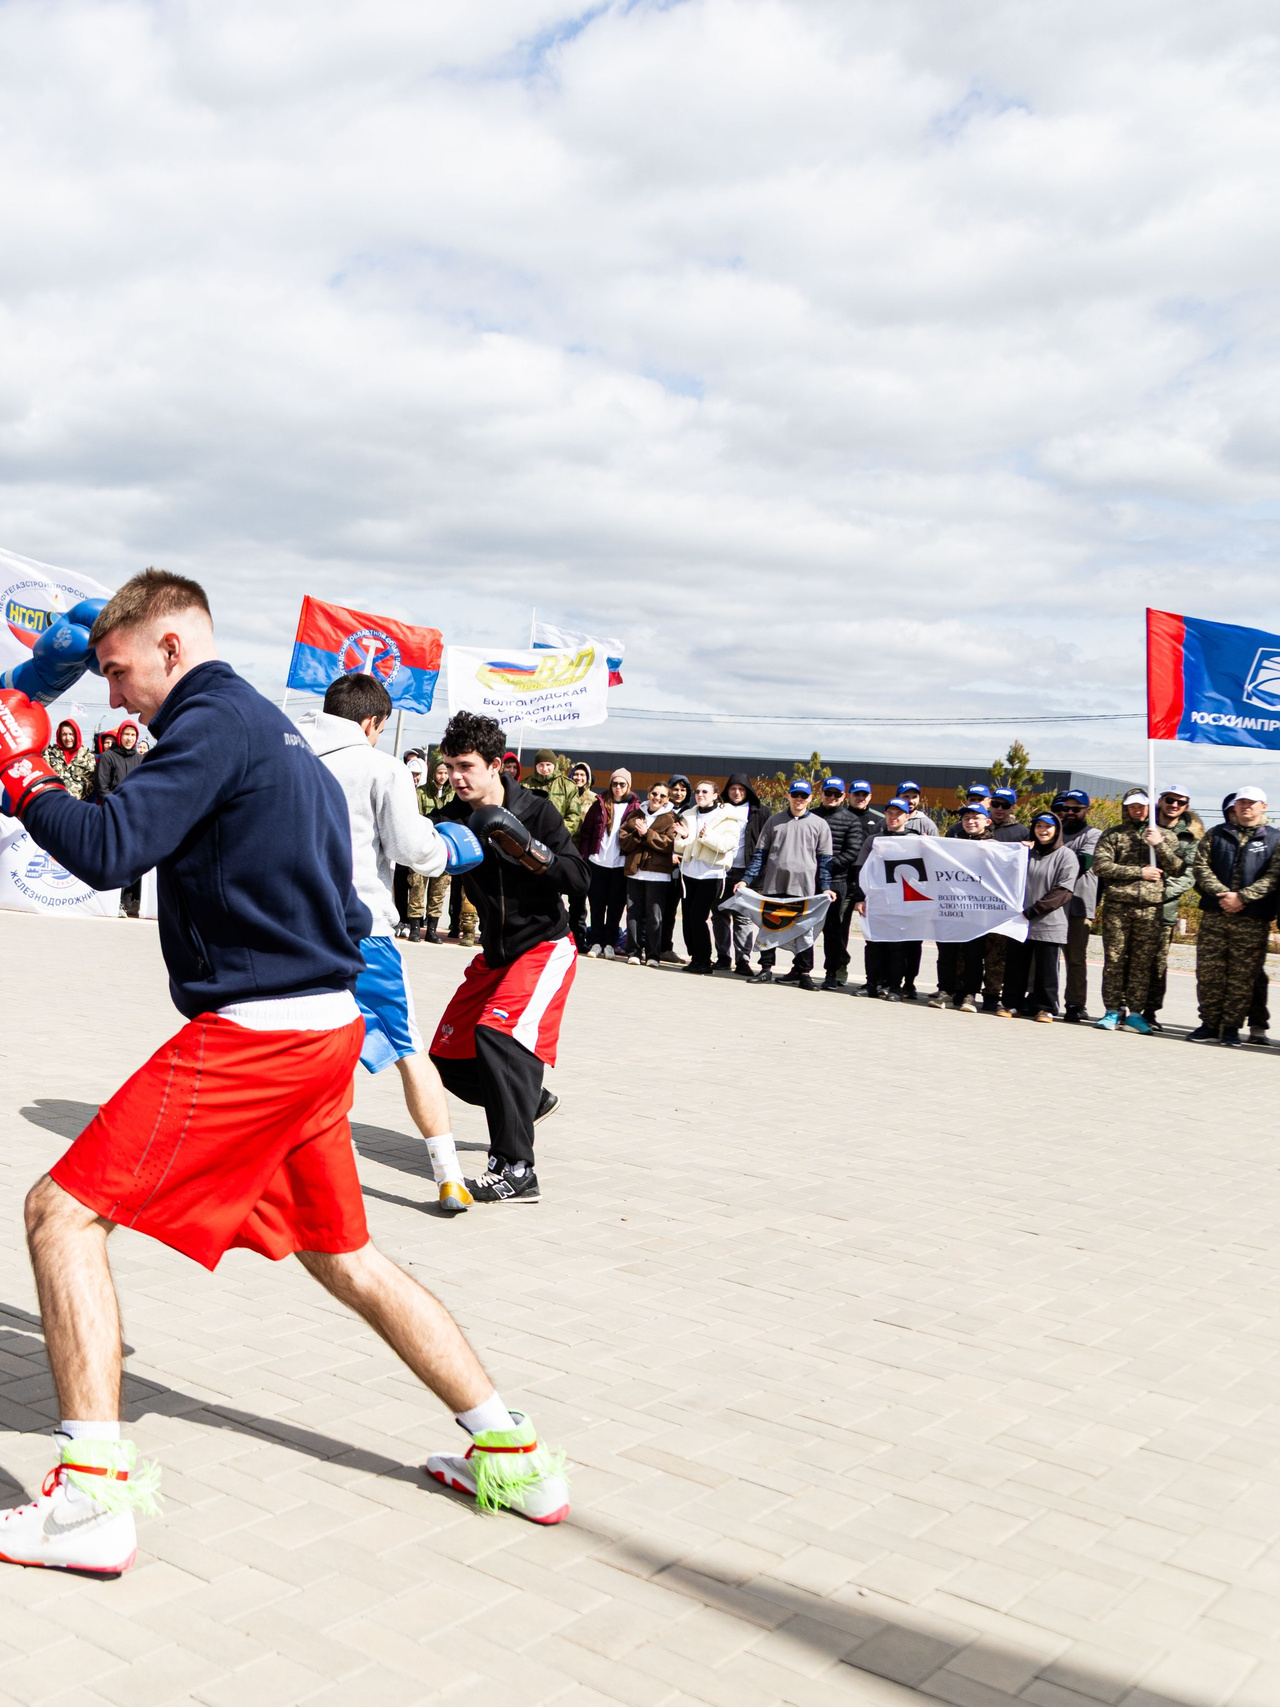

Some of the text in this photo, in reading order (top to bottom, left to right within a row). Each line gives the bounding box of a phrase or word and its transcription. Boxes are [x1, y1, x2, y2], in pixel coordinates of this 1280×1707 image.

[9, 602, 45, 631] НГСП
[1191, 710, 1280, 731] РОСХИМПР
[938, 895, 1006, 904] ВОЛГОГРАДСКИ
[939, 903, 1008, 911] АЛЮМИНИЕВЫЙ
